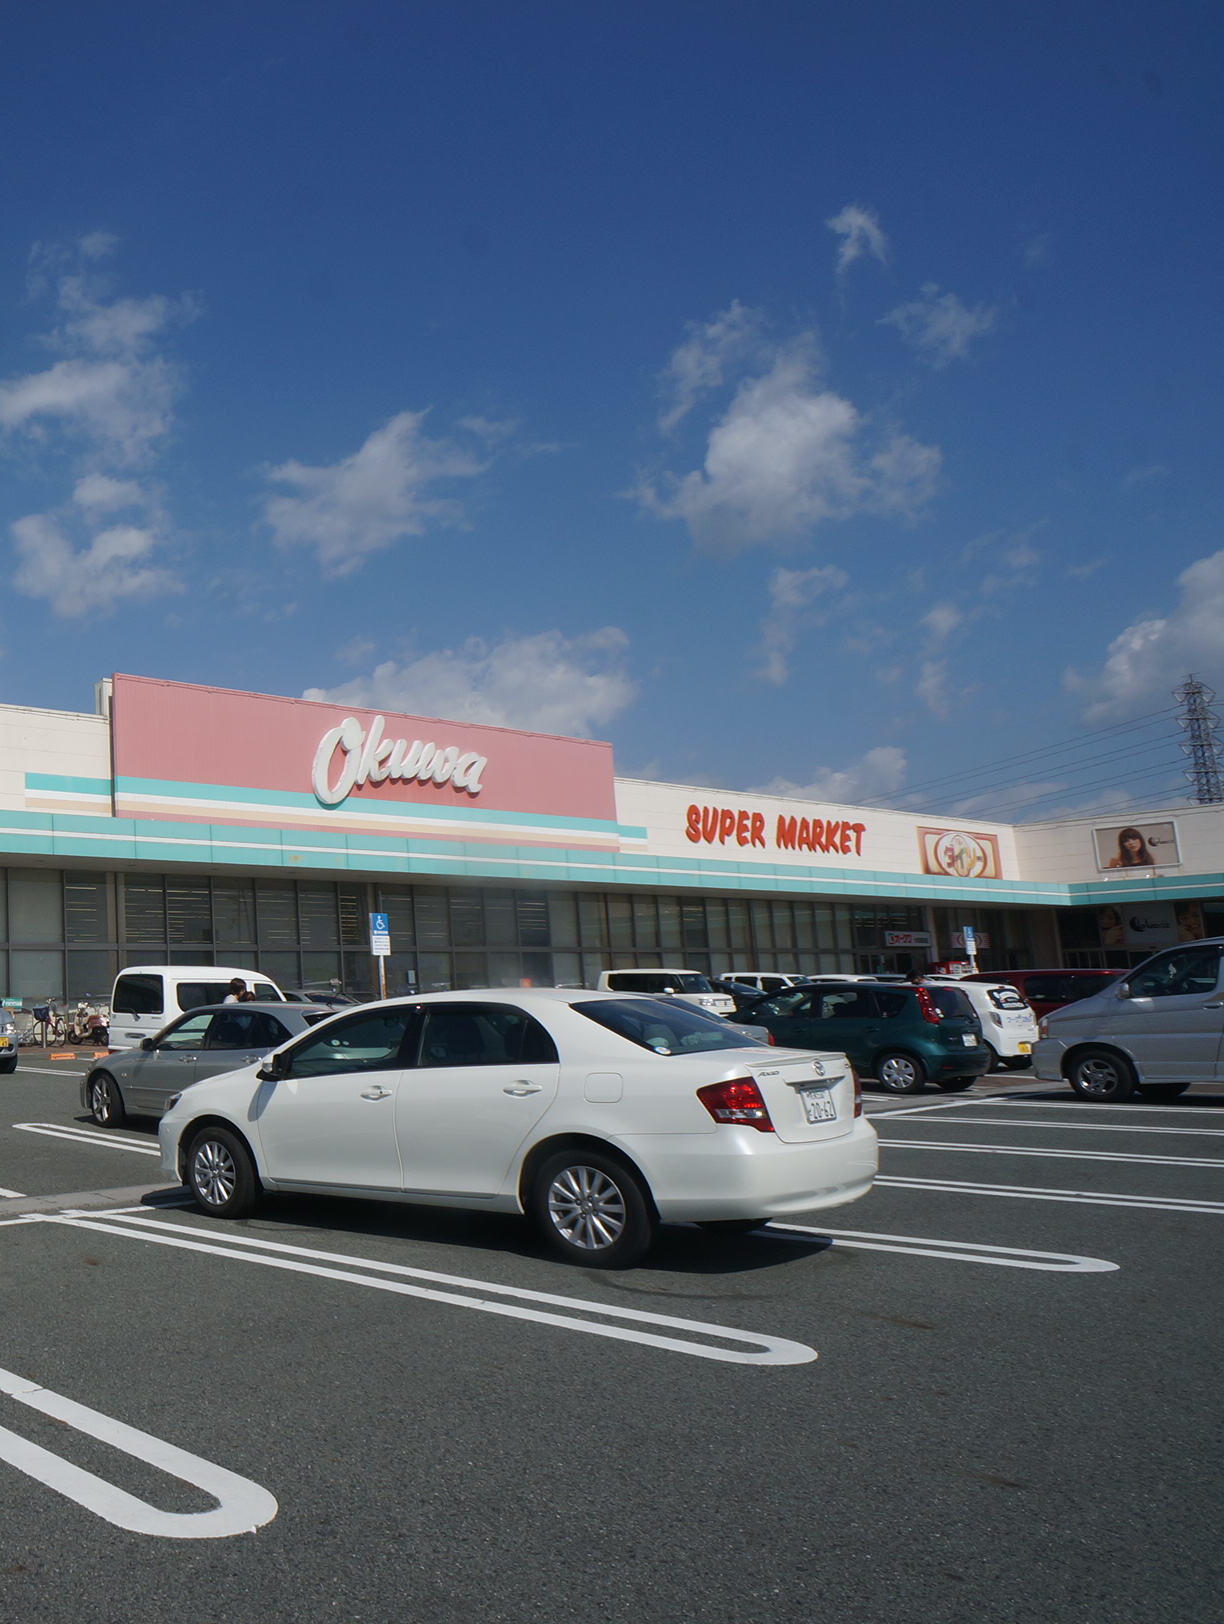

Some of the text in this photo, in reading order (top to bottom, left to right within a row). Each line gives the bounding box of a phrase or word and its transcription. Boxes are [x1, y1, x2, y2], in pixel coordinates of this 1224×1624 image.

[311, 715, 488, 805] Okuwa
[685, 804, 866, 857] SUPER MARKET
